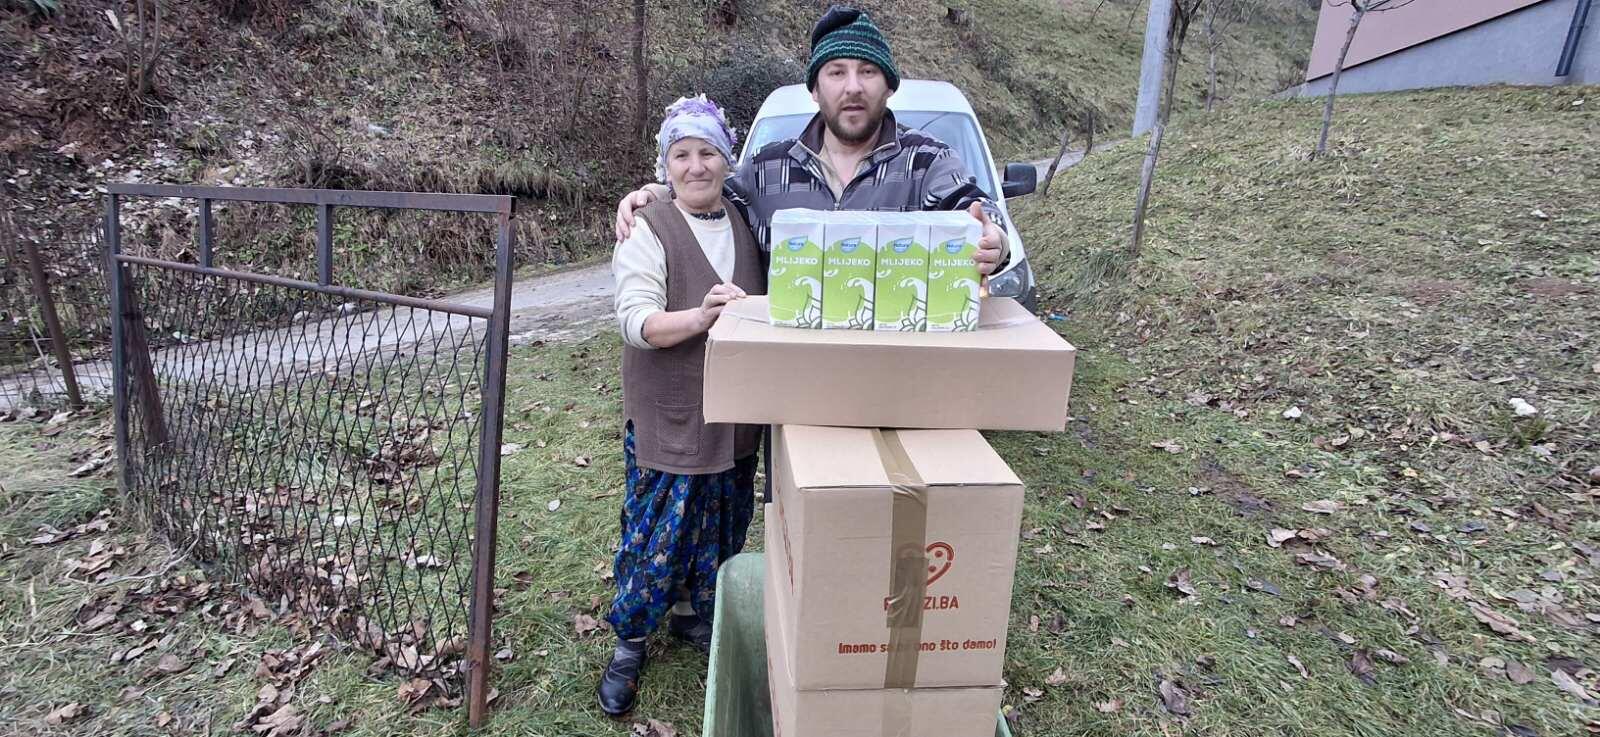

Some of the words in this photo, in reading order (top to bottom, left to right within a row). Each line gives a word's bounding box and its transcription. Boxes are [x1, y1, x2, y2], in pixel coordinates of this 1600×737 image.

[775, 255, 818, 266] MLIJEKO
[828, 257, 871, 267] MLIJEKO
[881, 257, 924, 267] MLIJEKO
[934, 257, 976, 267] MLIJEKO
[838, 642, 877, 654] Imamo
[940, 639, 960, 651] što
[962, 638, 997, 650] damo!
